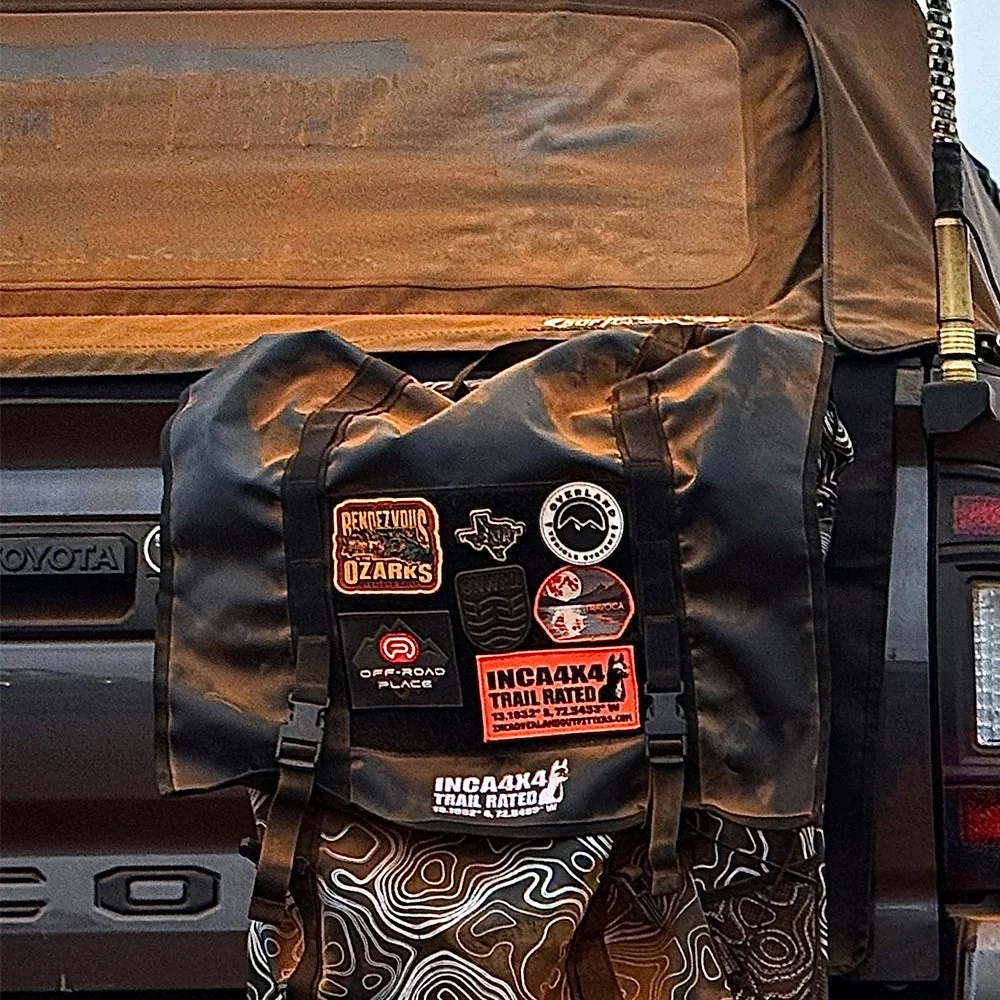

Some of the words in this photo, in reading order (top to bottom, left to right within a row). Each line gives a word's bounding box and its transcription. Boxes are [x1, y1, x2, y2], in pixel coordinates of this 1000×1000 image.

[549, 488, 616, 518] OVERLAND
[341, 508, 430, 543] RENDEZVOUS
[0, 545, 119, 572] OYOTA
[344, 560, 433, 585] OZARKS
[360, 667, 446, 679] OFF-ROAD
[377, 680, 433, 690] PLACE
[486, 663, 606, 691] INCA4X4
[488, 689, 541, 710] TRAIL
[543, 685, 596, 706] RATED
[434, 769, 548, 793] INCA4X4
[433, 793, 482, 809] TRAIL
[485, 790, 538, 809] RATED
